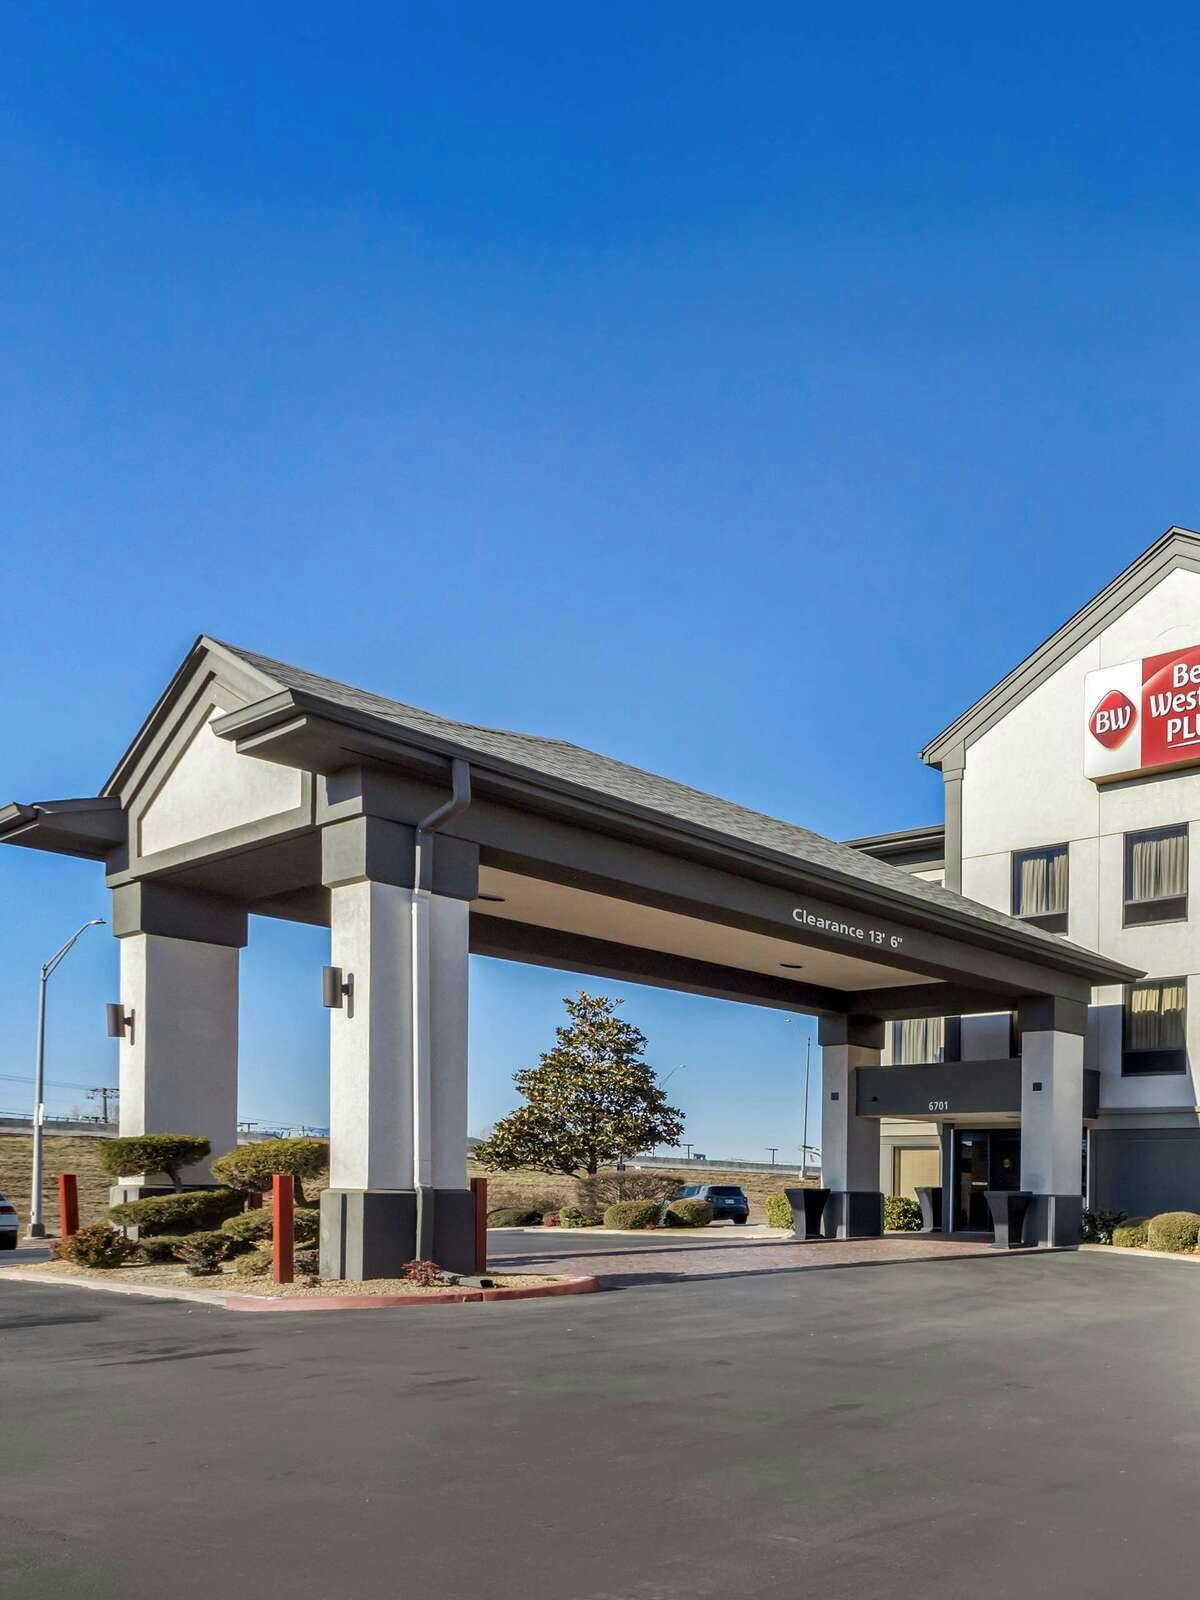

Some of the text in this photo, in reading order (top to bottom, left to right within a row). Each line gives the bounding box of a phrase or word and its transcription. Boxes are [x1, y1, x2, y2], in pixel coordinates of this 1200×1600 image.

[1095, 705, 1131, 734] BW
[792, 908, 864, 939] Clearance
[868, 930, 886, 944] 13'
[928, 1101, 949, 1111] 6701
